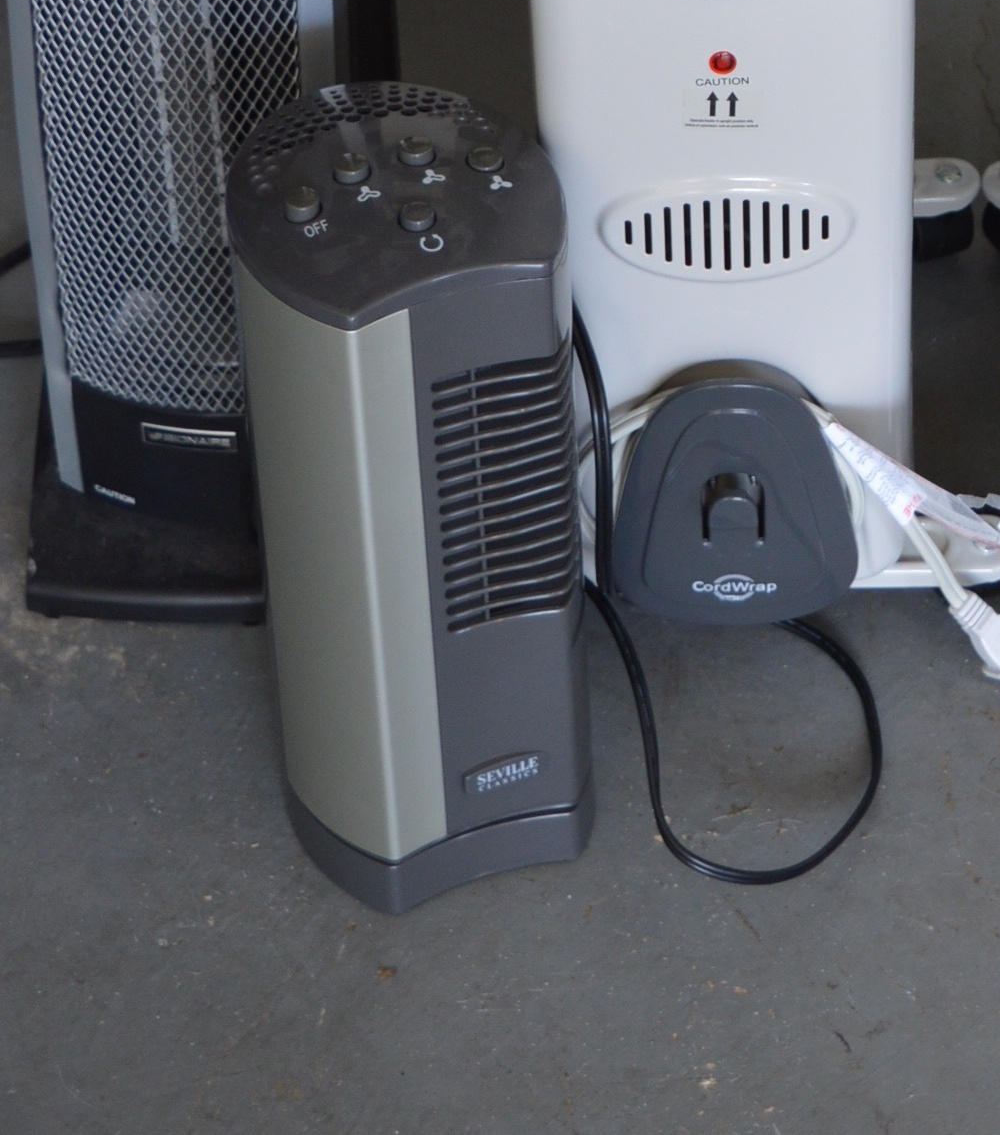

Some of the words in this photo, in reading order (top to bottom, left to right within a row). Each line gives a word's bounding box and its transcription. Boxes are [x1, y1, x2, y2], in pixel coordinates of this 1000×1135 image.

[695, 76, 750, 87] CAUTION
[303, 219, 330, 238] OFF
[692, 580, 778, 594] CordWrap
[476, 755, 540, 786] SEVILLE
[477, 768, 539, 793] CLASSICS
